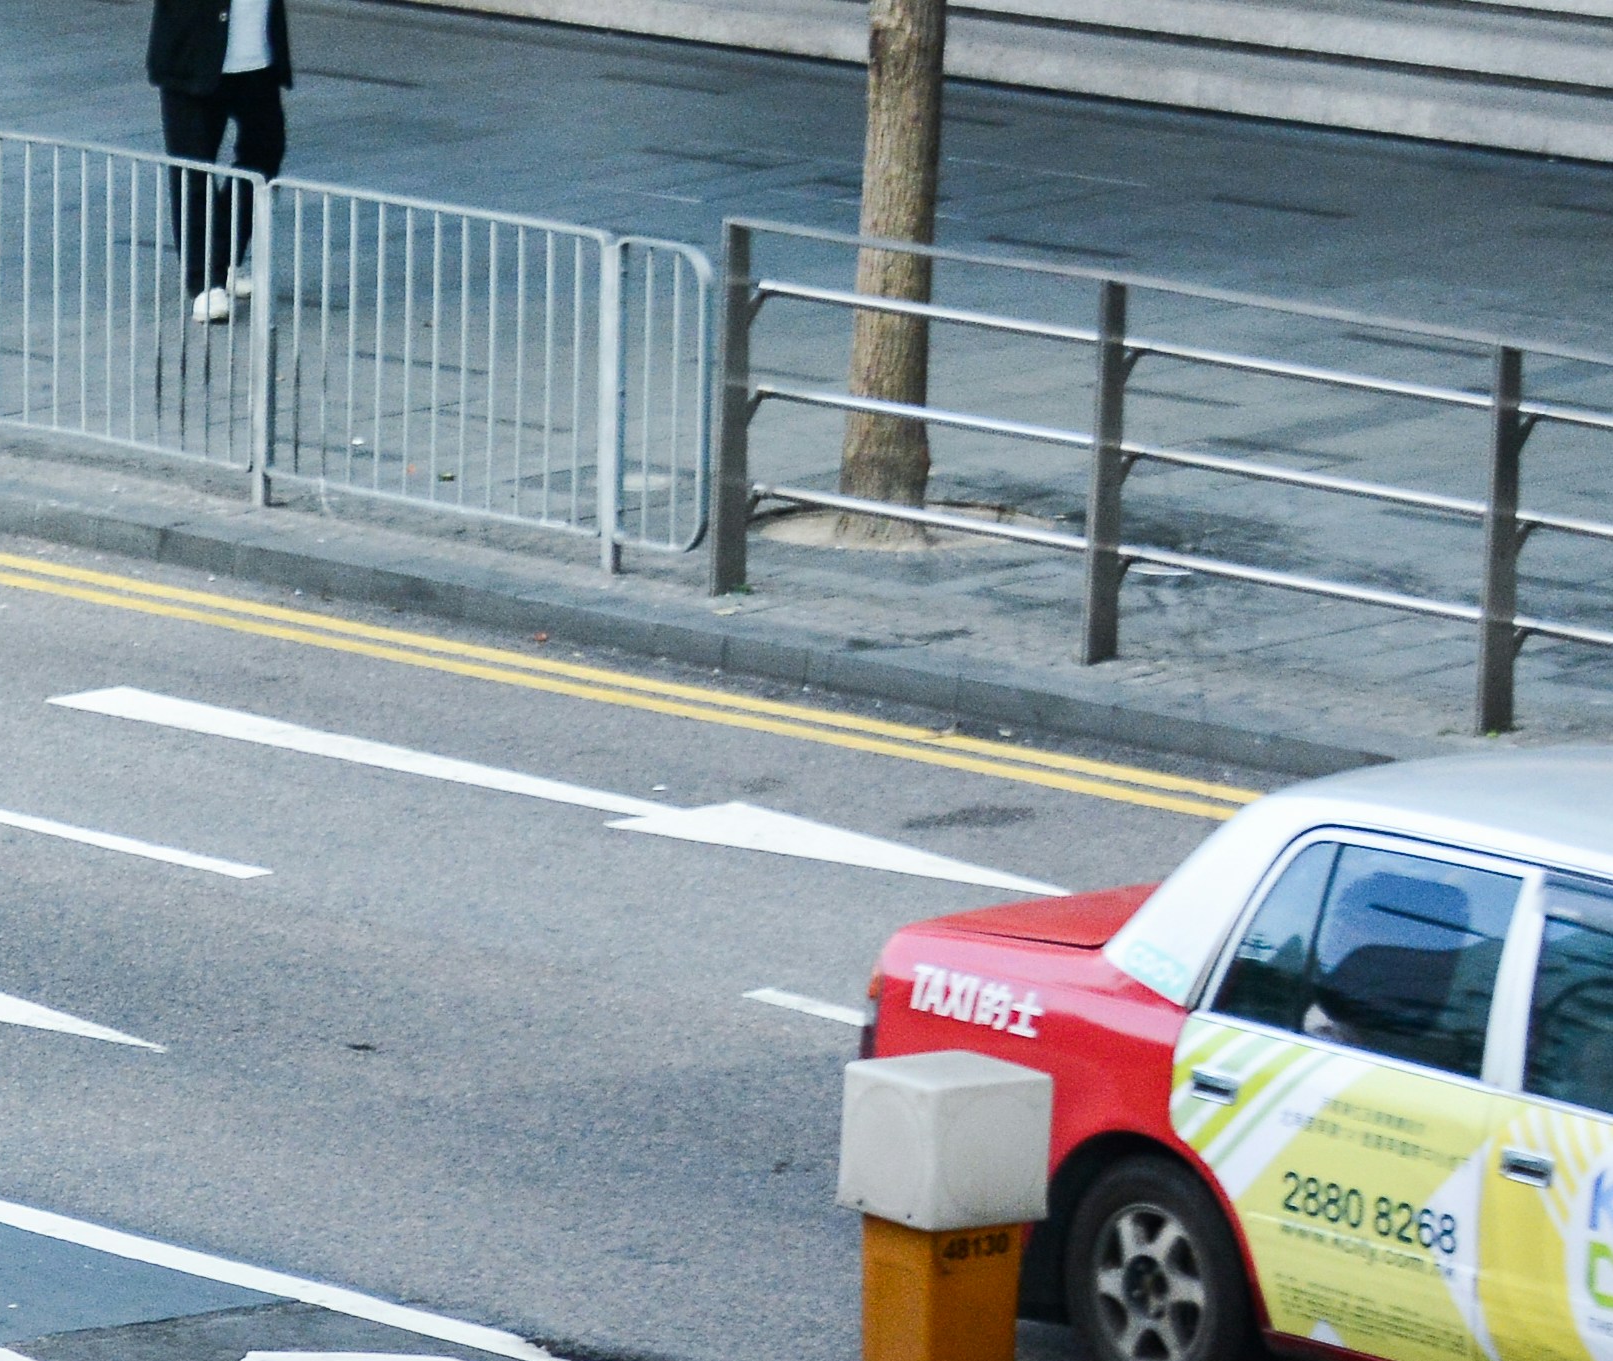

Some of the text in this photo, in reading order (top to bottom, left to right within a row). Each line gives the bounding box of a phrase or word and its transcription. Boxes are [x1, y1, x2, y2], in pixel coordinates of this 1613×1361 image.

[910, 963, 1044, 1039] TAXI 的士
[942, 1233, 1010, 1260] 48130
[1283, 1171, 1456, 1254] 2880 8268
